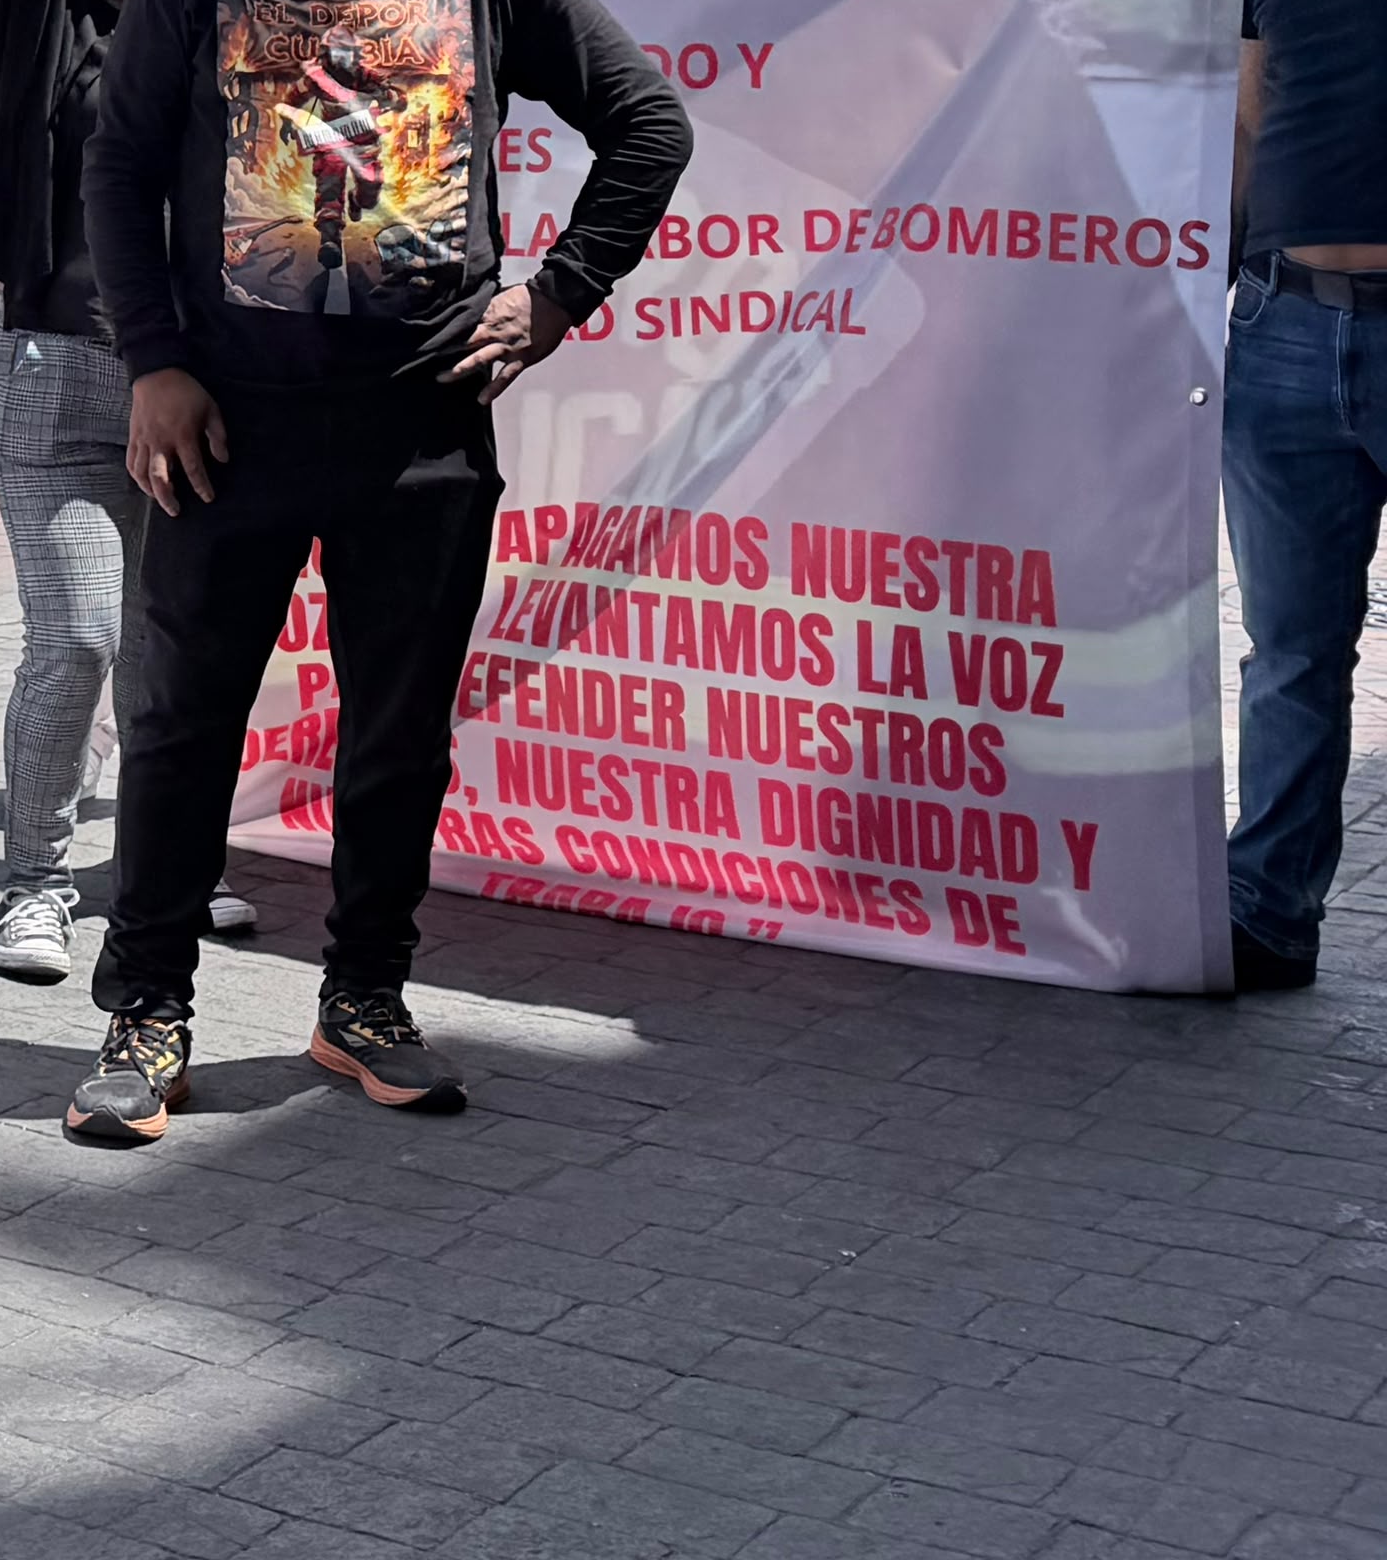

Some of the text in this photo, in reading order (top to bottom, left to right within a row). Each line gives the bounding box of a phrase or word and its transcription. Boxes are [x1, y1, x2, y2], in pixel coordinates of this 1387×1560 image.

[253, 0, 295, 26] EL
[264, 29, 425, 67] CUBIA
[738, 43, 774, 90] Y
[871, 203, 1211, 271] BOMBEROS
[635, 288, 867, 342] SINDICAL
[496, 501, 1058, 630] APAGAMOS NUESTRA
[493, 574, 835, 687] LEVANTAMOS
[857, 618, 927, 701] LA
[948, 631, 1066, 719] VOZ
[457, 650, 688, 754] EFENDER
[706, 681, 1008, 797] NUESTROS
[495, 737, 741, 841] NUESTRA
[758, 777, 1040, 887] DIGNIDAD
[1061, 819, 1100, 893] Y
[555, 823, 931, 937] CONDICIONES
[945, 883, 1027, 957] DE
